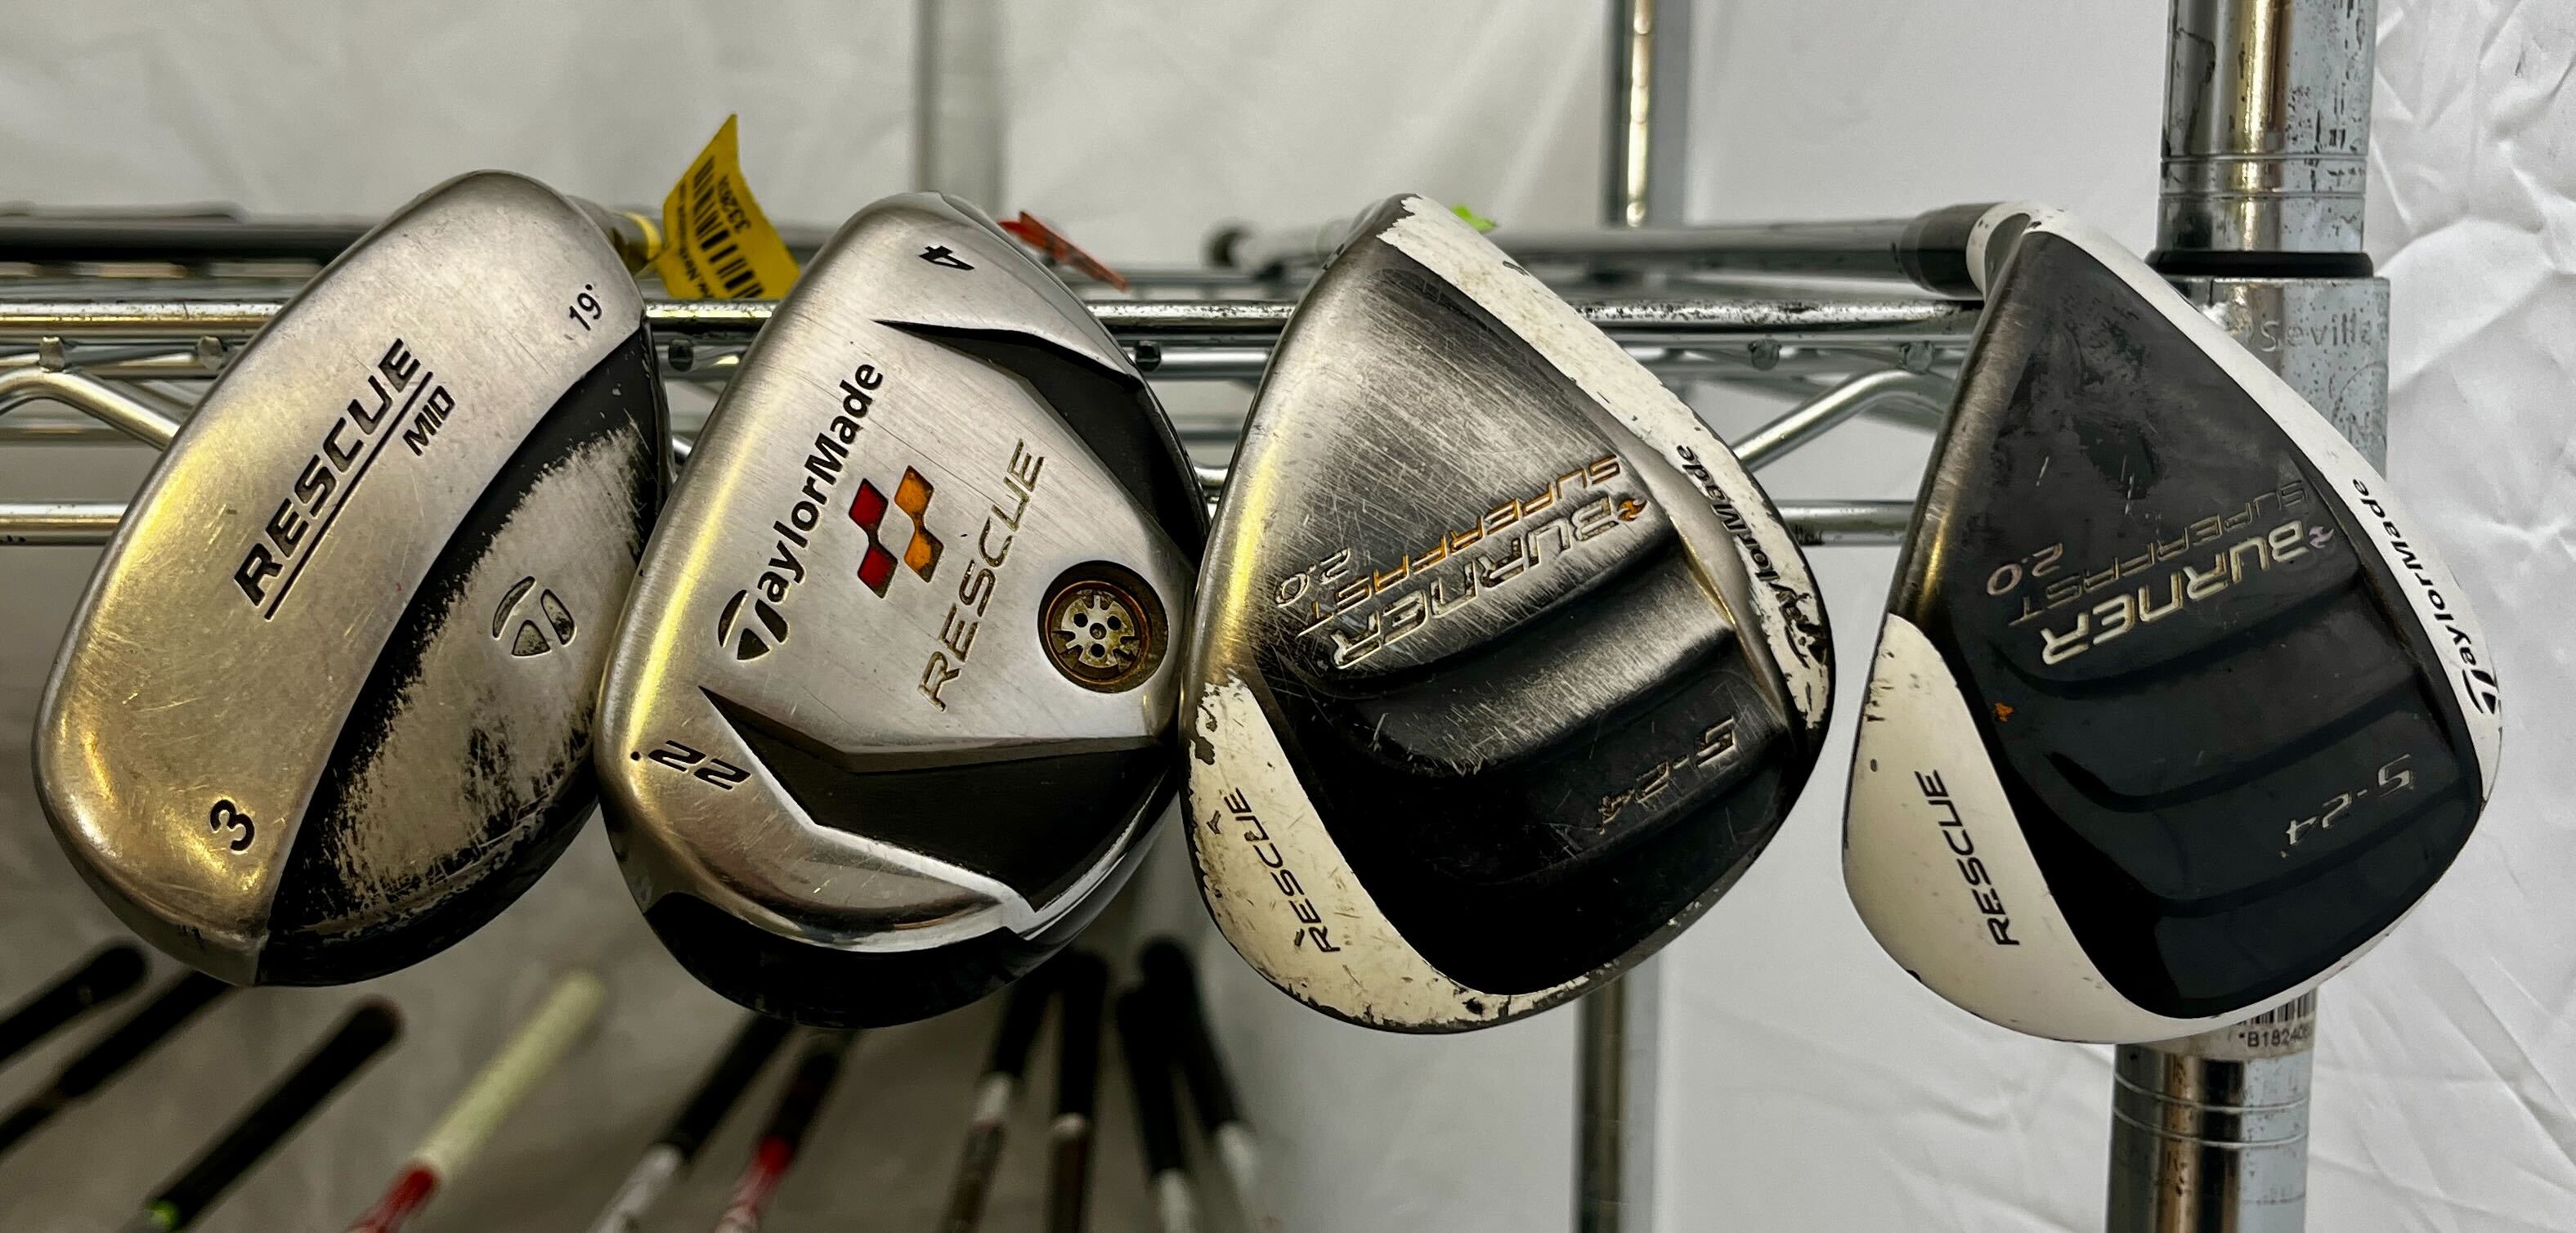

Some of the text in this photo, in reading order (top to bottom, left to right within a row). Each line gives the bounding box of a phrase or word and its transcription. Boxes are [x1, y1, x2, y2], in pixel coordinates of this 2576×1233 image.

[918, 245, 975, 271] 4
[234, 338, 422, 607] RESCUE
[402, 384, 456, 456] MID
[717, 362, 884, 661] TaylorMade
[917, 438, 1046, 712] RESCUE
[1274, 453, 1620, 638] SUPERFAST 2.0
[1330, 494, 1620, 670] BURNER
[1986, 479, 2310, 627] SUPERFAST 2.0
[2040, 520, 2309, 666] BURNER
[2352, 478, 2501, 715] TaylorMade
[209, 799, 255, 853] 3
[1224, 787, 1341, 953] RESCUE
[1914, 769, 2020, 945] RESCUE
